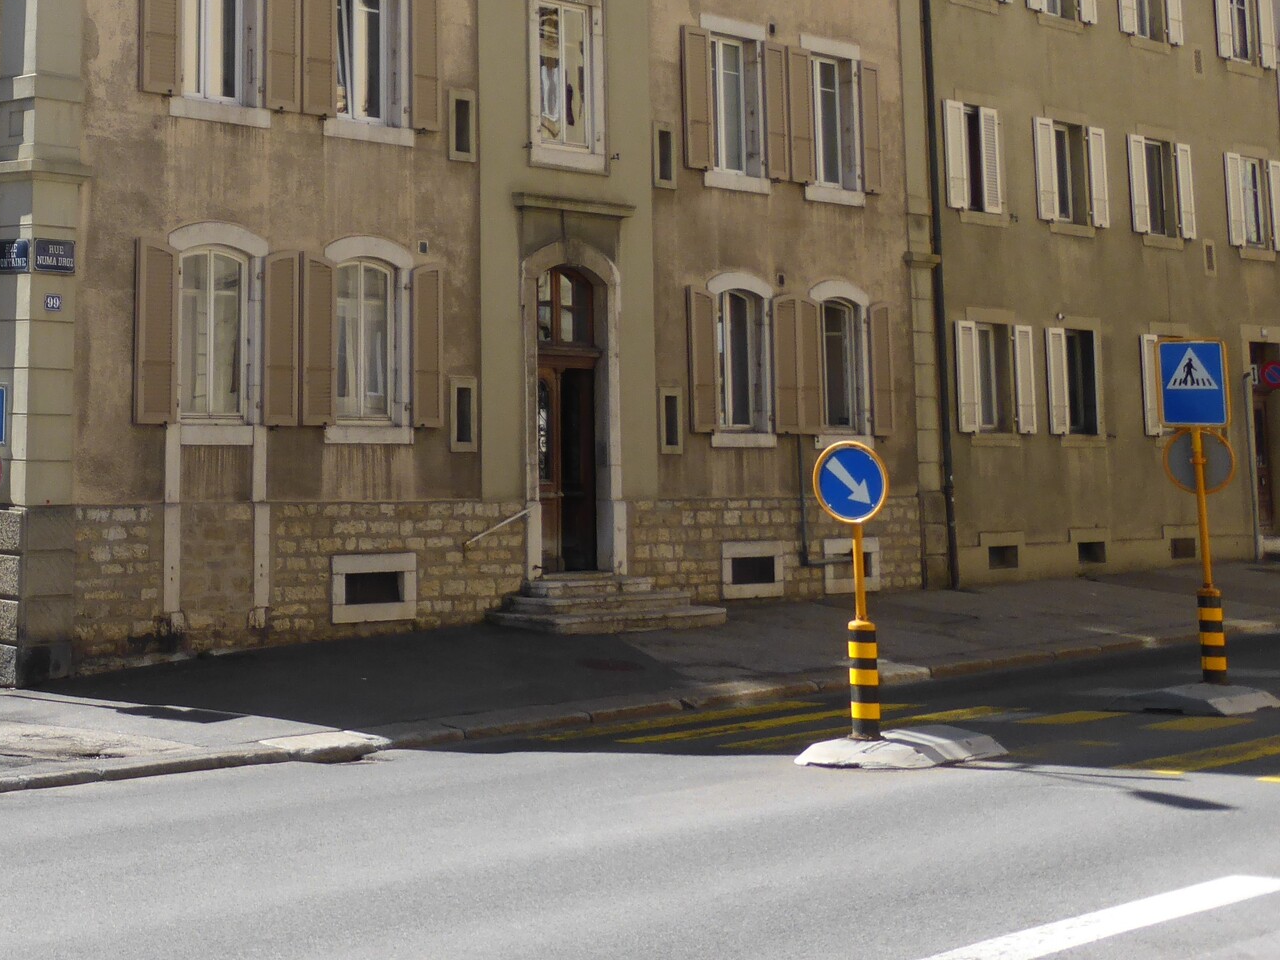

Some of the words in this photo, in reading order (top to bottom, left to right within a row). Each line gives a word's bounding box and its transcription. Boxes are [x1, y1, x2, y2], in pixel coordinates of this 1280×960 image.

[5, 244, 18, 252] RUE
[48, 245, 64, 254] RUE
[37, 256, 57, 265] NUMA
[58, 257, 73, 266] DROZ
[47, 297, 59, 308] 99
